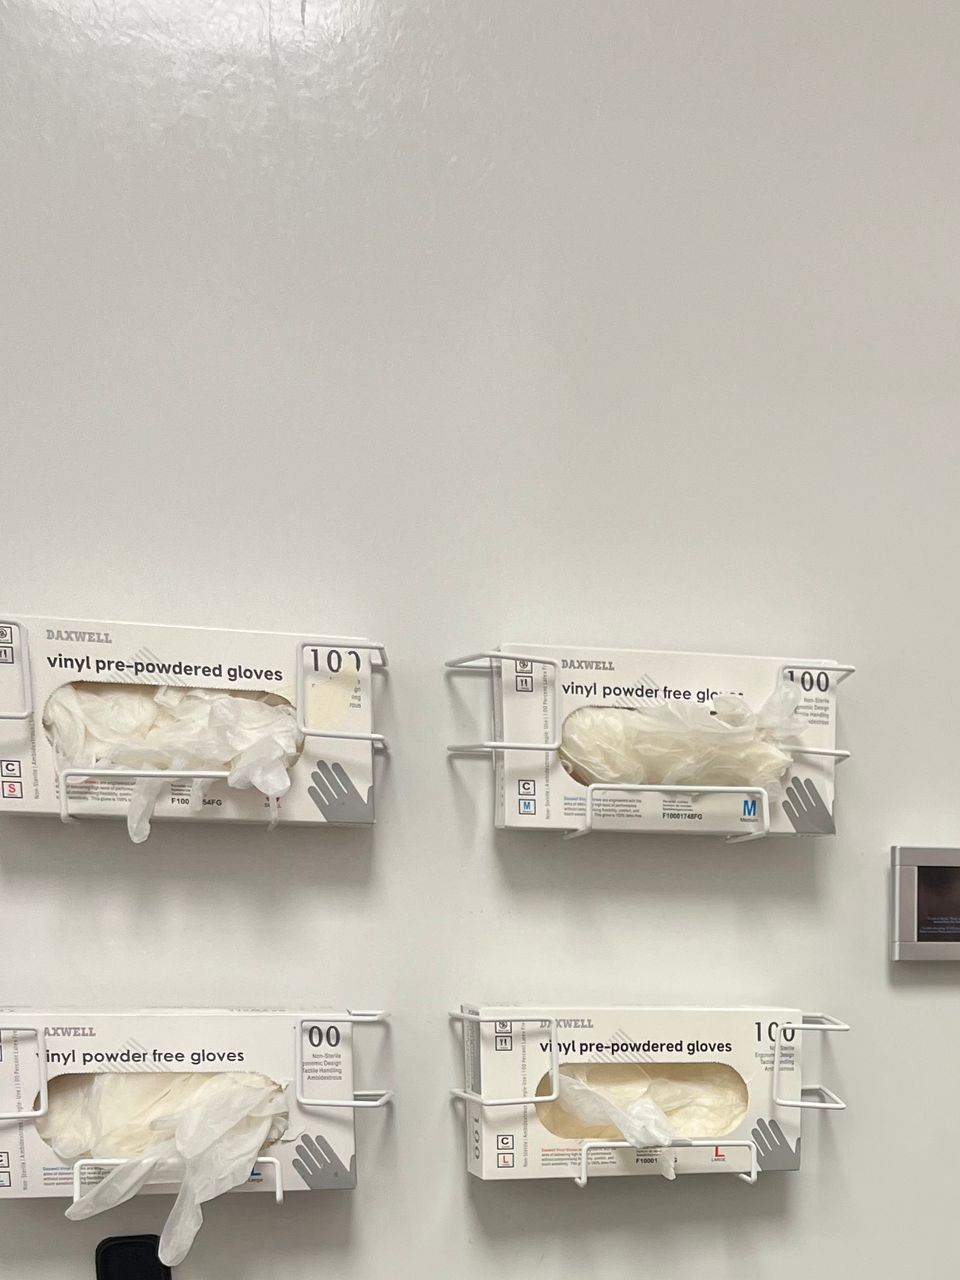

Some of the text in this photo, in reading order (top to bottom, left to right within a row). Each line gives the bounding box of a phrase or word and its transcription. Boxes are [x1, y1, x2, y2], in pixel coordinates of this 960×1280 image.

[46, 629, 113, 644] DAXWELL
[47, 653, 283, 682] vinyl pre-powdered gloves
[561, 659, 615, 671] DAXWELL
[562, 682, 597, 698] vinyl
[603, 685, 660, 699] powder
[664, 687, 692, 700] free
[6, 763, 16, 772] C
[9, 784, 16, 794] S
[523, 782, 531, 791] C
[524, 802, 531, 810] M
[743, 800, 757, 817] M
[44, 1027, 97, 1037] AXWELL
[309, 1026, 341, 1048] 00
[755, 1021, 795, 1042] 100
[580, 1041, 682, 1055] pre-powdered
[687, 1041, 733, 1055] gloves
[36, 1049, 245, 1066] inyl powder free gloves
[501, 1137, 509, 1145] C
[715, 1146, 726, 1158] L
[503, 1155, 509, 1164] L
